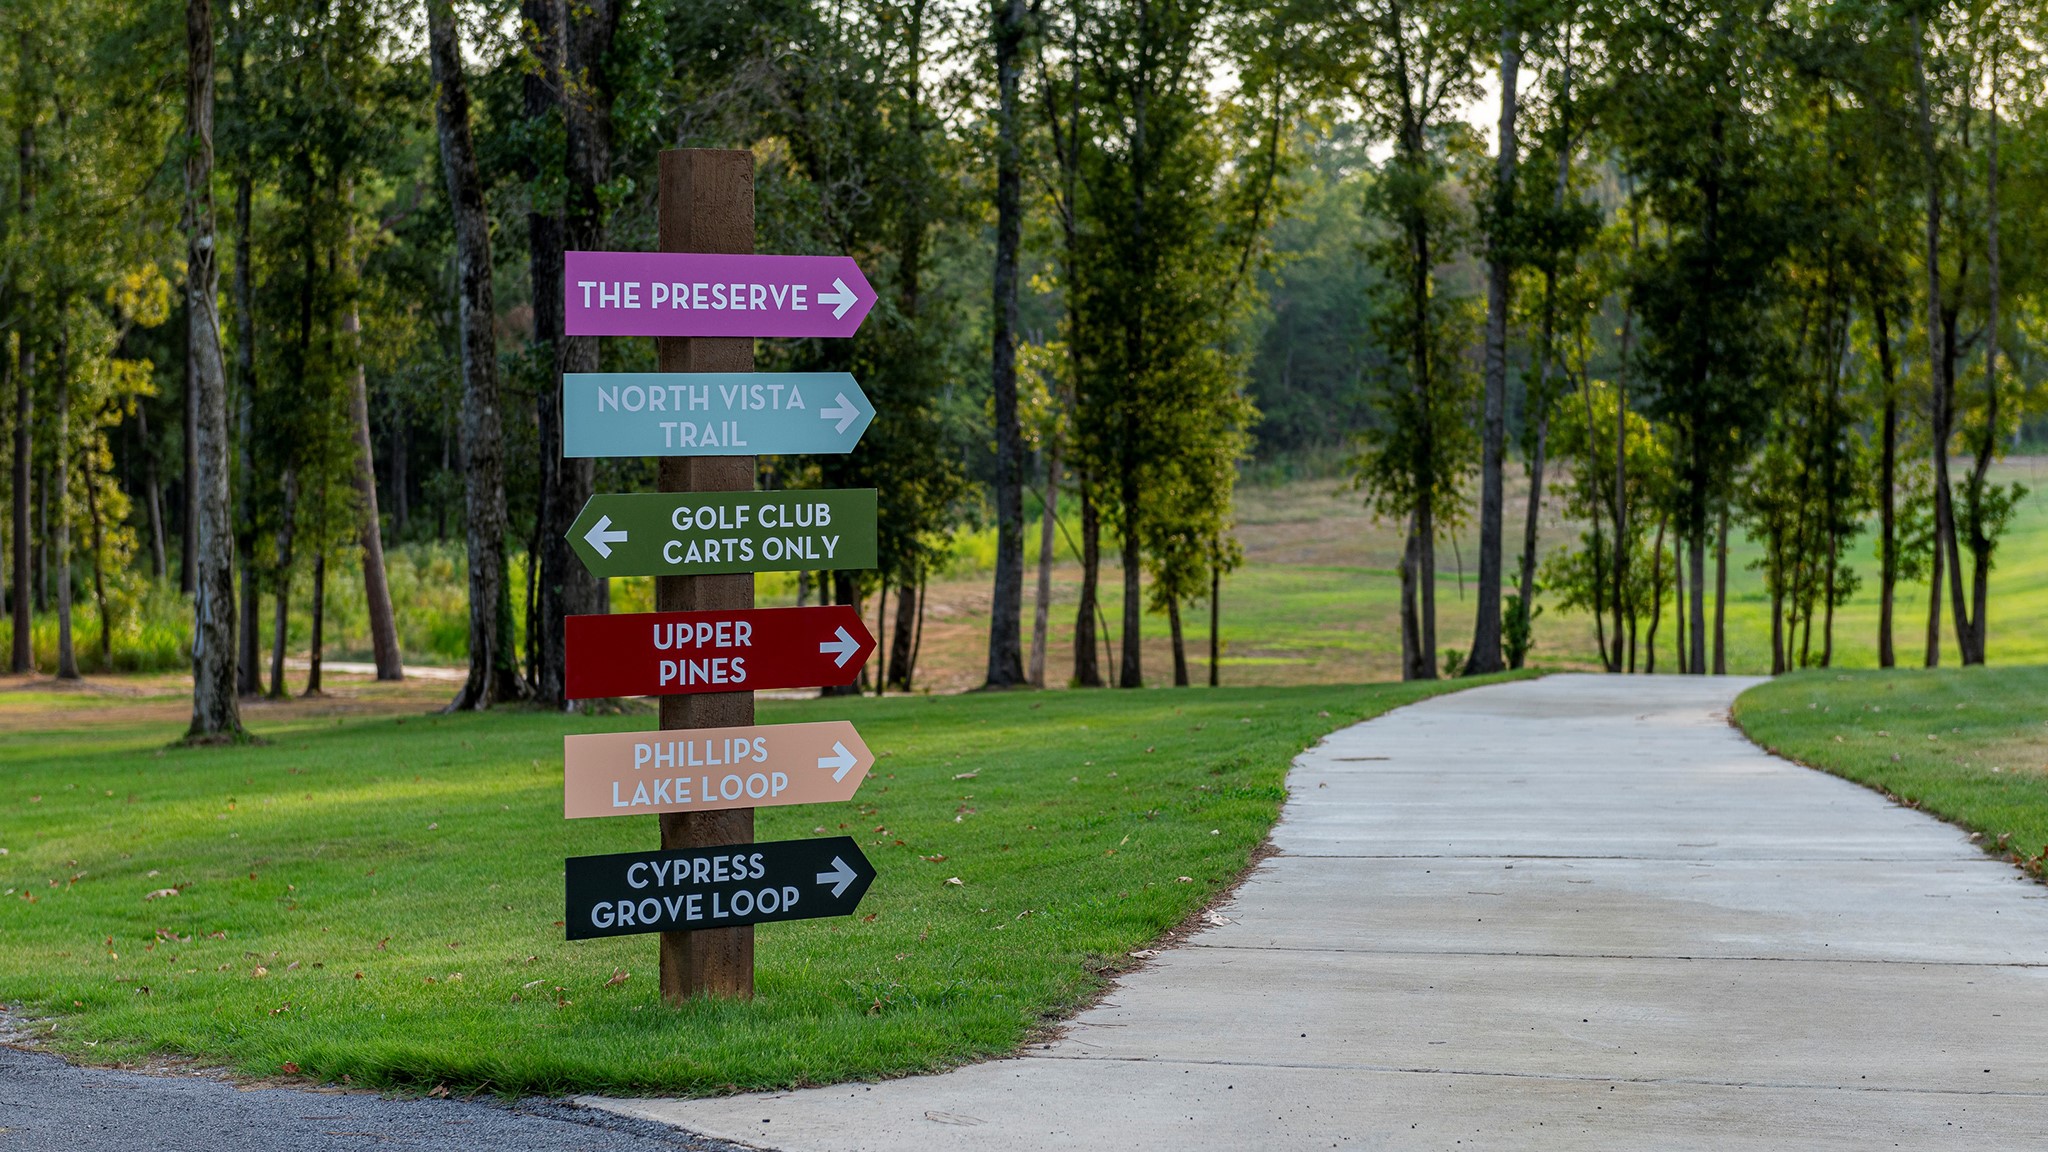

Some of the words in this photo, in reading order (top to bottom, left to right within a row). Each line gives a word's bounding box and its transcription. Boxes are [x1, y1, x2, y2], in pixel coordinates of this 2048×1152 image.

[578, 282, 641, 308] THE
[652, 283, 808, 311] PRESERVE
[598, 385, 709, 412] NORTH
[719, 384, 806, 410] VISTA
[659, 421, 748, 448] TRAIL
[671, 505, 750, 531] GOLF
[758, 504, 831, 528] CLUB
[663, 538, 754, 564] CARTS
[762, 535, 840, 560] ONLY
[653, 621, 753, 650] UPPER
[659, 657, 747, 687] PINES
[634, 736, 769, 769] PHILLIPS
[612, 777, 692, 807] LAKE
[702, 772, 789, 802] LOOP
[627, 853, 765, 889] CYPRESS
[591, 894, 703, 929] GROVE
[713, 886, 800, 919] LOOP
